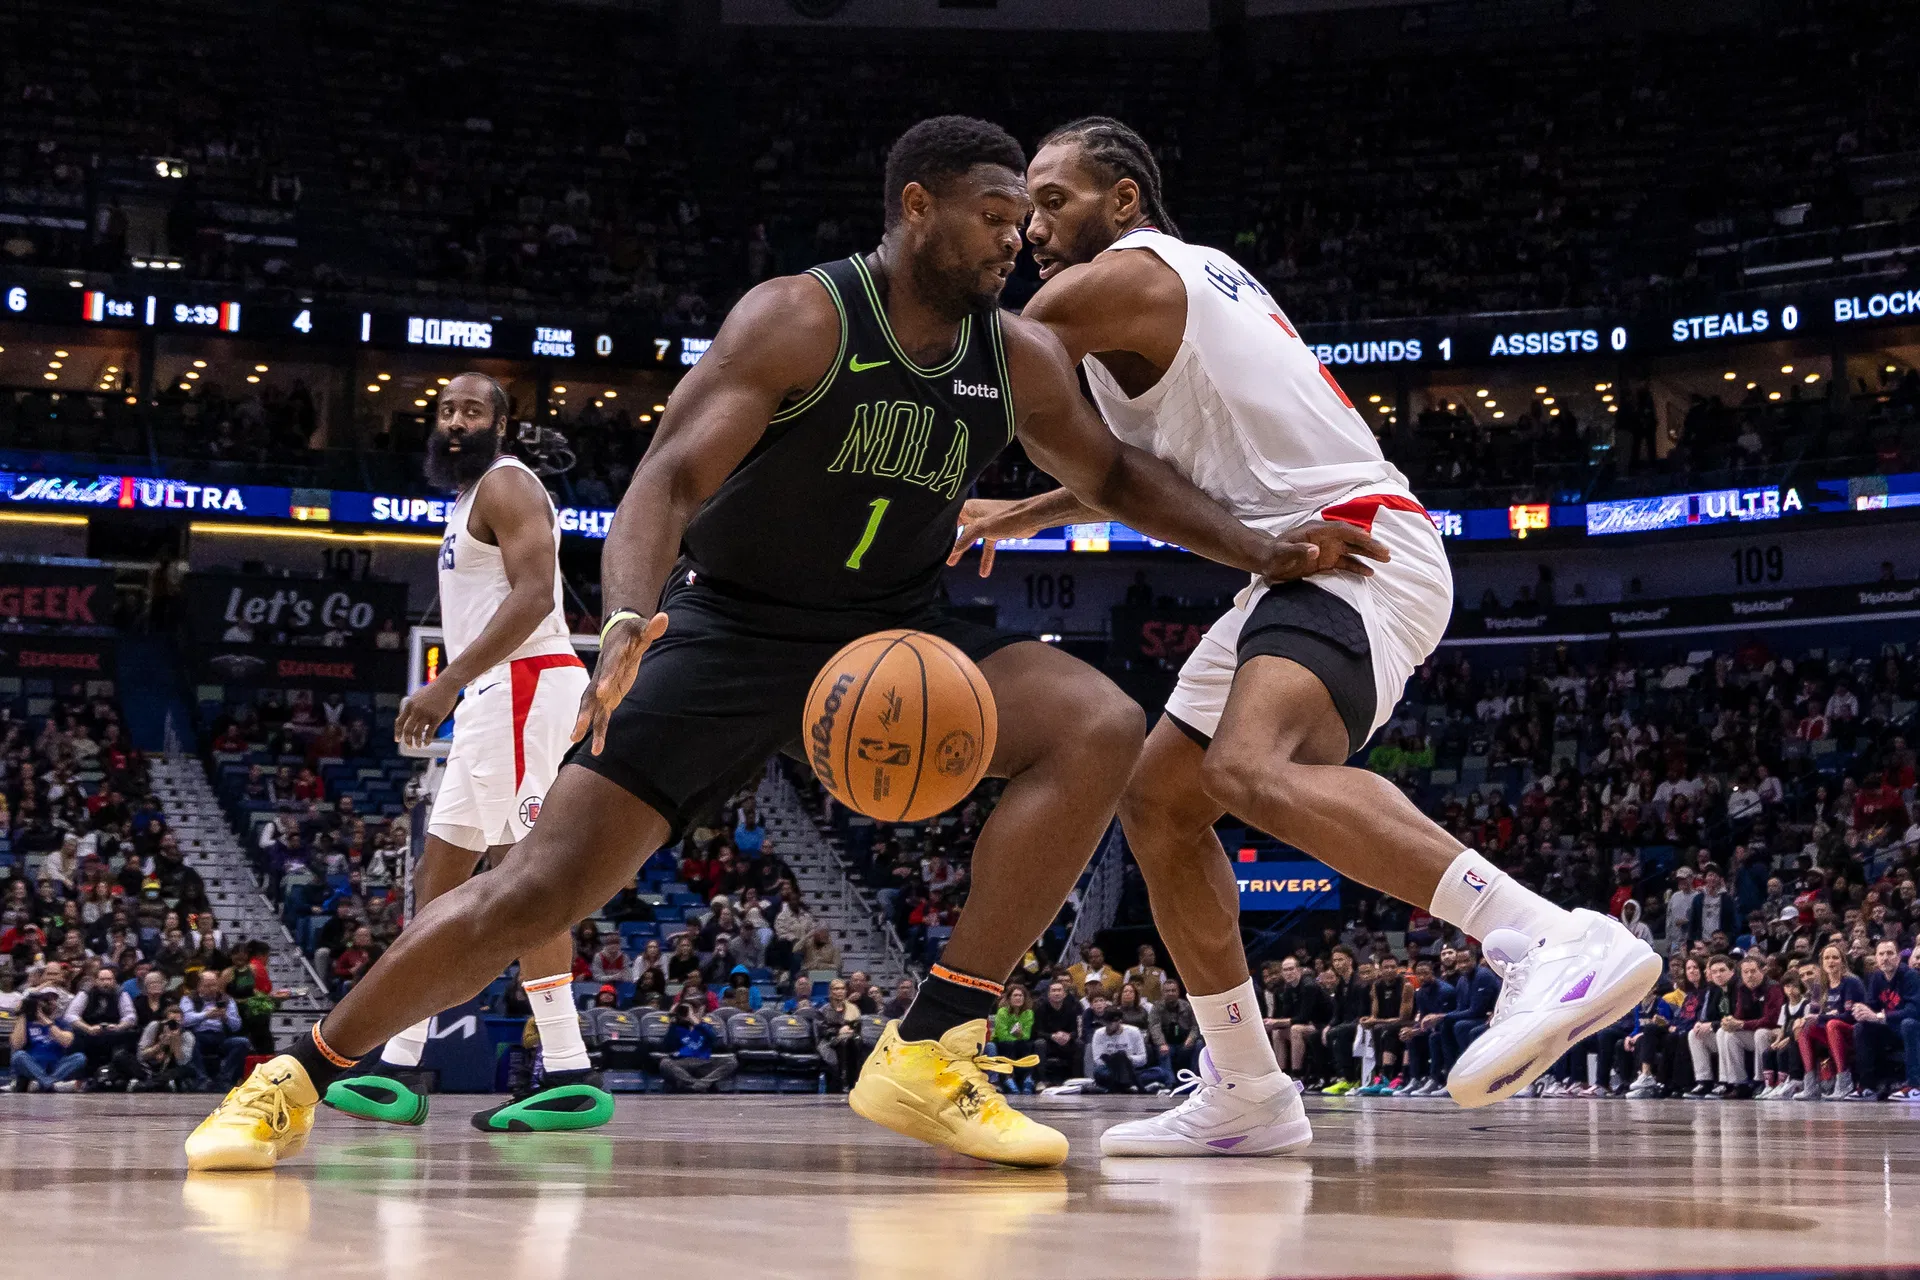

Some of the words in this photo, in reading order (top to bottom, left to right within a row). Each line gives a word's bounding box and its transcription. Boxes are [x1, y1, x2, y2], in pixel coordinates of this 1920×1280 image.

[8, 287, 28, 311] 6
[106, 300, 135, 317] 1st
[1834, 290, 1920, 322] BLOCK
[174, 304, 219, 325] 9:39
[292, 309, 313, 333] 4
[1672, 310, 1769, 341] STEALS
[1782, 306, 1798, 330] 0
[536, 327, 572, 342] TEAM
[597, 335, 612, 356] 0
[1490, 330, 1599, 357] ASSISTS
[1611, 327, 1627, 350] 0
[533, 341, 575, 357] FOULS
[654, 339, 671, 360] 7
[1306, 338, 1422, 365] BOUNDS
[1438, 338, 1451, 361] 1
[953, 379, 999, 399] ibotta
[827, 400, 969, 500] NOLA
[141, 487, 246, 510] ULTRA
[1706, 488, 1802, 518] ULTRA
[553, 507, 615, 534] GHT
[845, 498, 891, 569] 1
[1731, 546, 1783, 585] 109
[0, 584, 97, 624] GEEK
[1025, 573, 1076, 609] 108
[224, 586, 313, 627] Let's
[320, 592, 374, 628] Go
